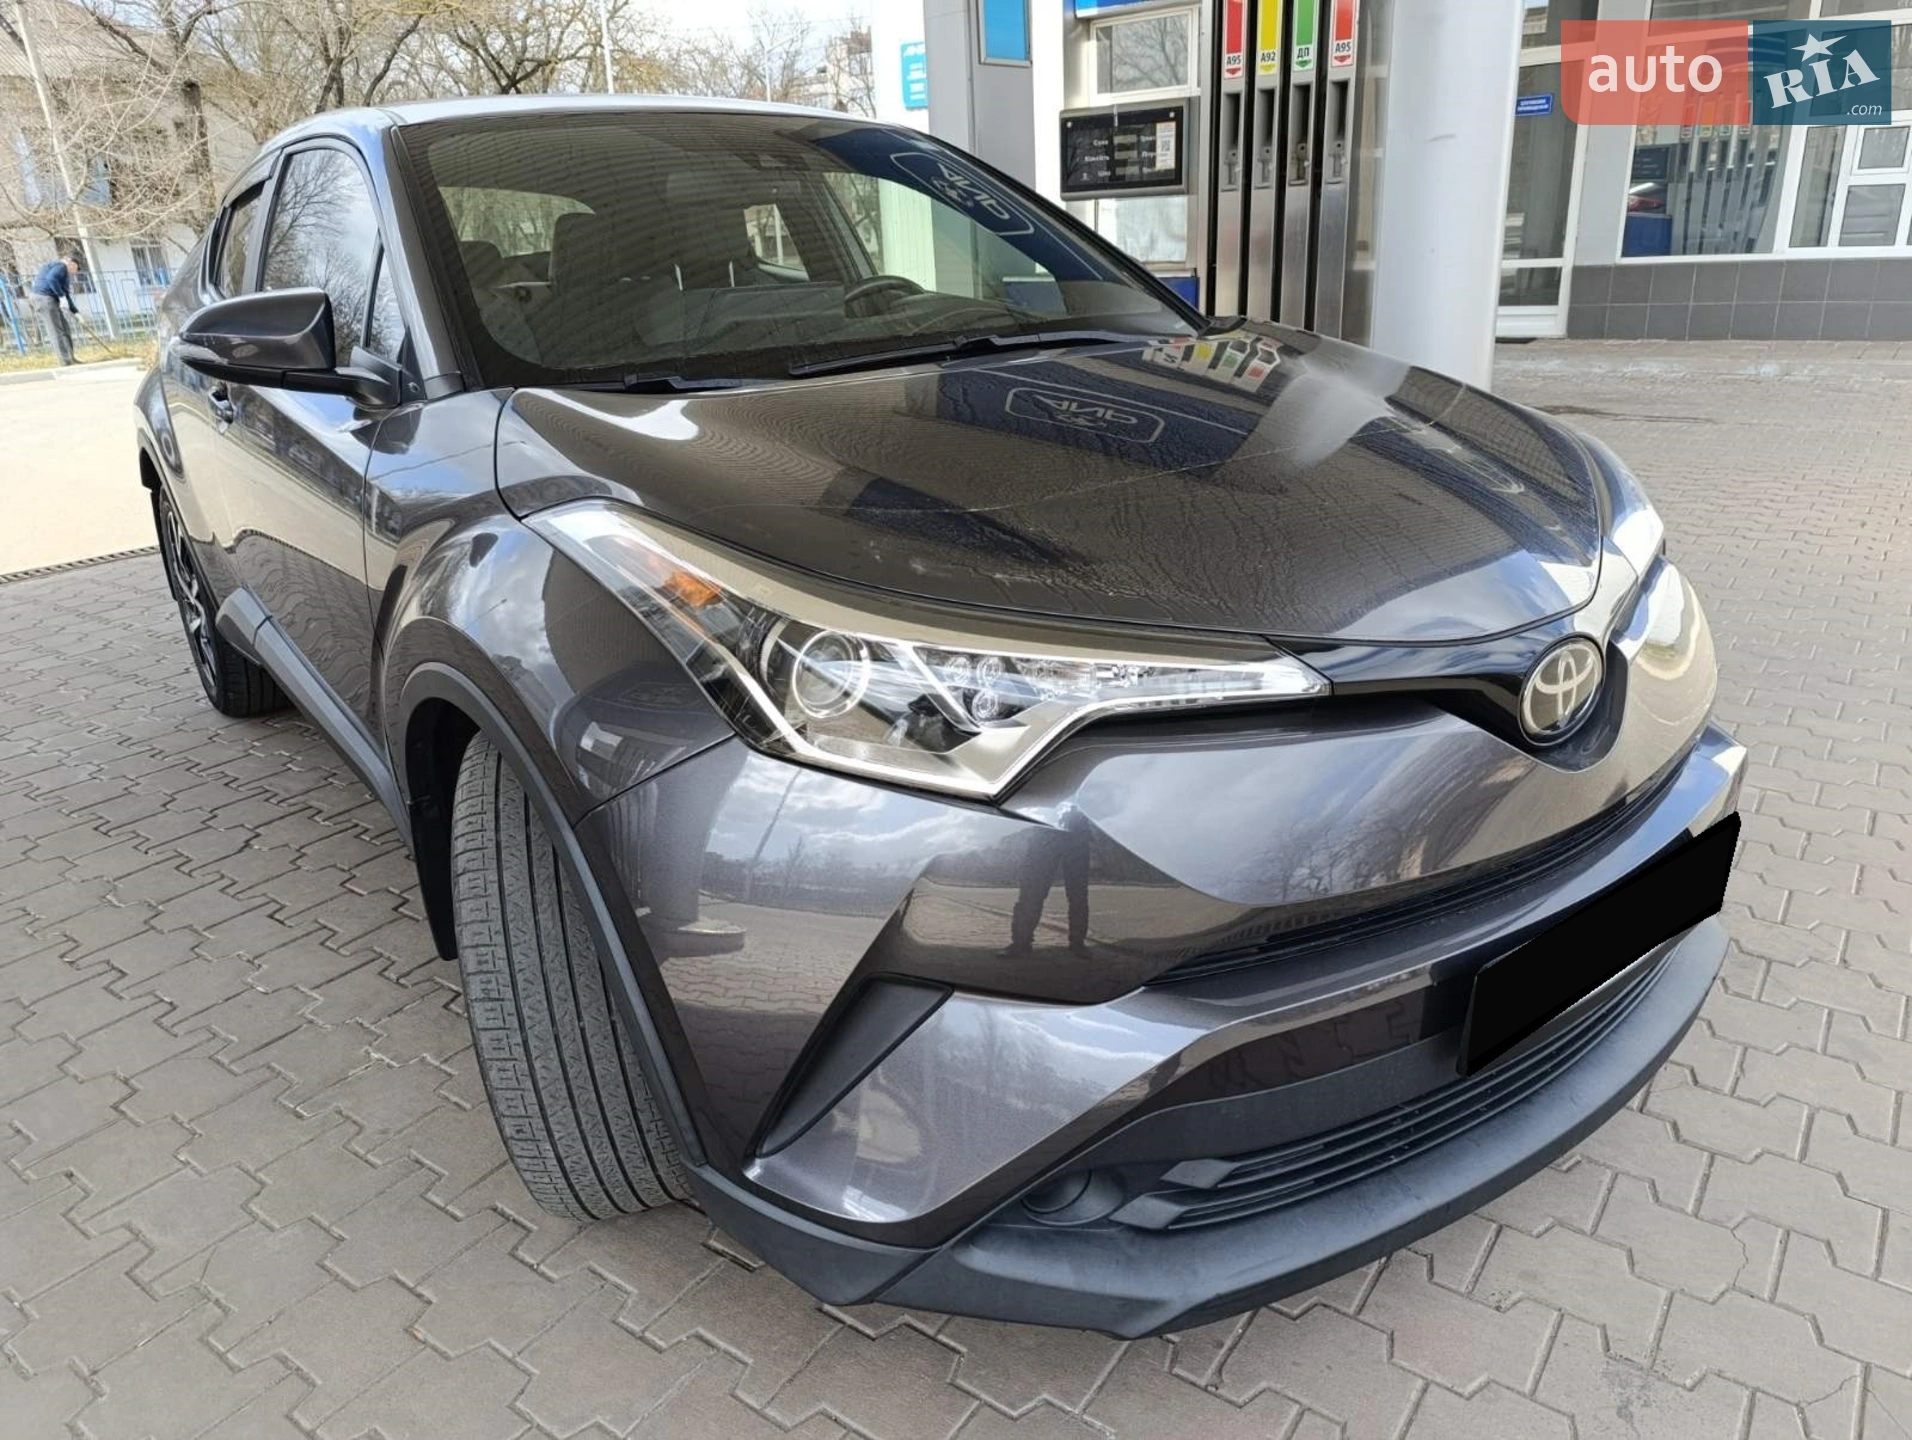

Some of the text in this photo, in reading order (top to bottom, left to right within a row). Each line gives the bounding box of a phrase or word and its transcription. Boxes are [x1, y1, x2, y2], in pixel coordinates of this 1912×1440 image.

[1297, 47, 1310, 59] ДП
[1334, 42, 1351, 53] А95
[1226, 54, 1241, 66] А95
[1260, 52, 1276, 63] А92
